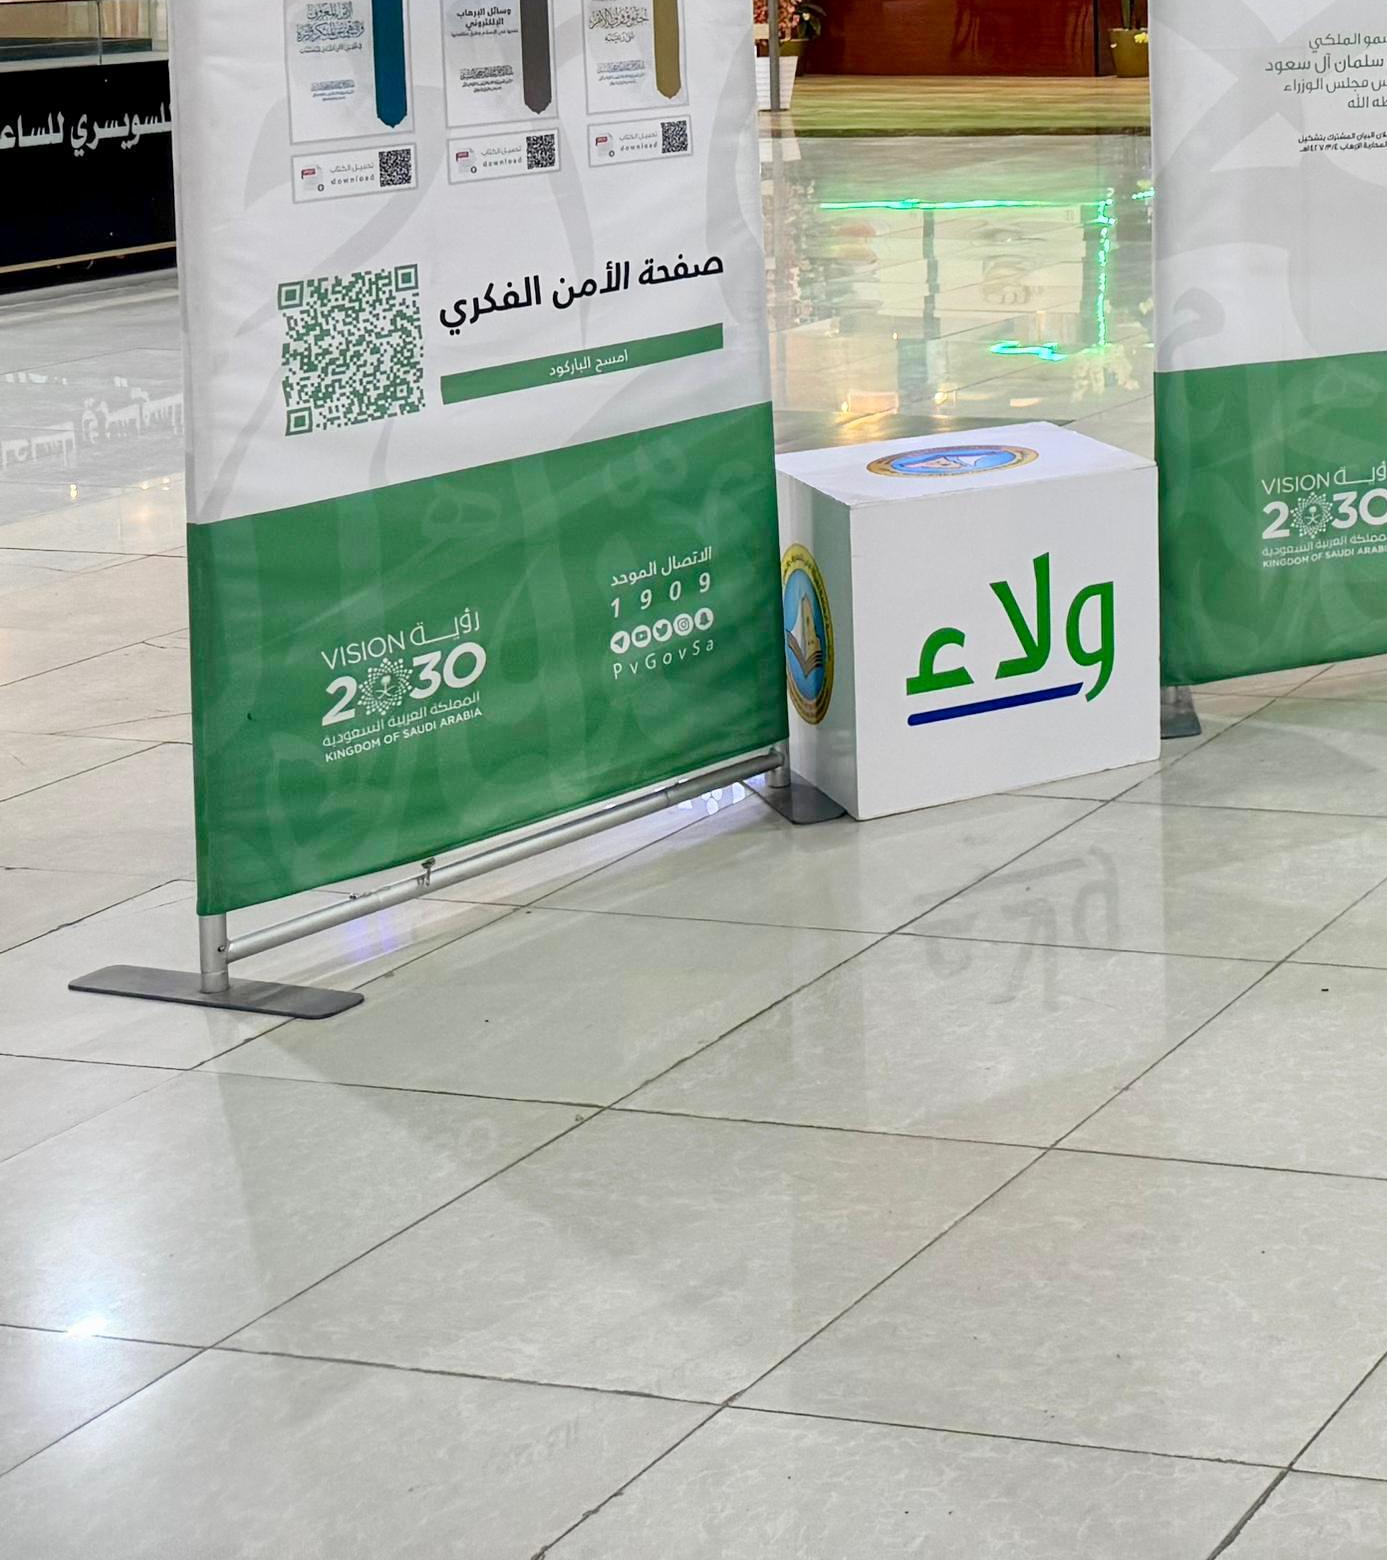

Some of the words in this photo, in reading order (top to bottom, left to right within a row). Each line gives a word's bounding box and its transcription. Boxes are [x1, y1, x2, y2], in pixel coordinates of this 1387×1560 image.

[1265, 61, 1310, 75] سعود
[1315, 53, 1330, 73] آل
[1334, 55, 1383, 73] سلمان
[620, 141, 657, 151] download
[483, 157, 522, 167] download
[331, 174, 374, 184] download
[639, 254, 723, 284] صفحة
[553, 261, 629, 309] الأمن
[440, 275, 541, 335] الفكري
[548, 354, 592, 378] الباركود
[1262, 472, 1331, 496] VISION
[1261, 541, 1314, 558] السعودية
[1314, 536, 1347, 550] العربية
[660, 544, 713, 577] الاتصال
[1262, 556, 1309, 568] KINGDOM
[1311, 552, 1323, 562] OF
[1325, 548, 1355, 559] SAUDI
[608, 559, 658, 588] الموحد
[906, 551, 1115, 703] ولاء
[321, 630, 406, 673] VISION
[429, 691, 481, 718] المملكة
[386, 705, 429, 733] العربية
[321, 717, 386, 750] السعودية
[324, 738, 382, 763] KINGDOM
[384, 732, 400, 746] OF
[402, 719, 437, 739] SAUDI
[440, 706, 483, 728] ARABIA
